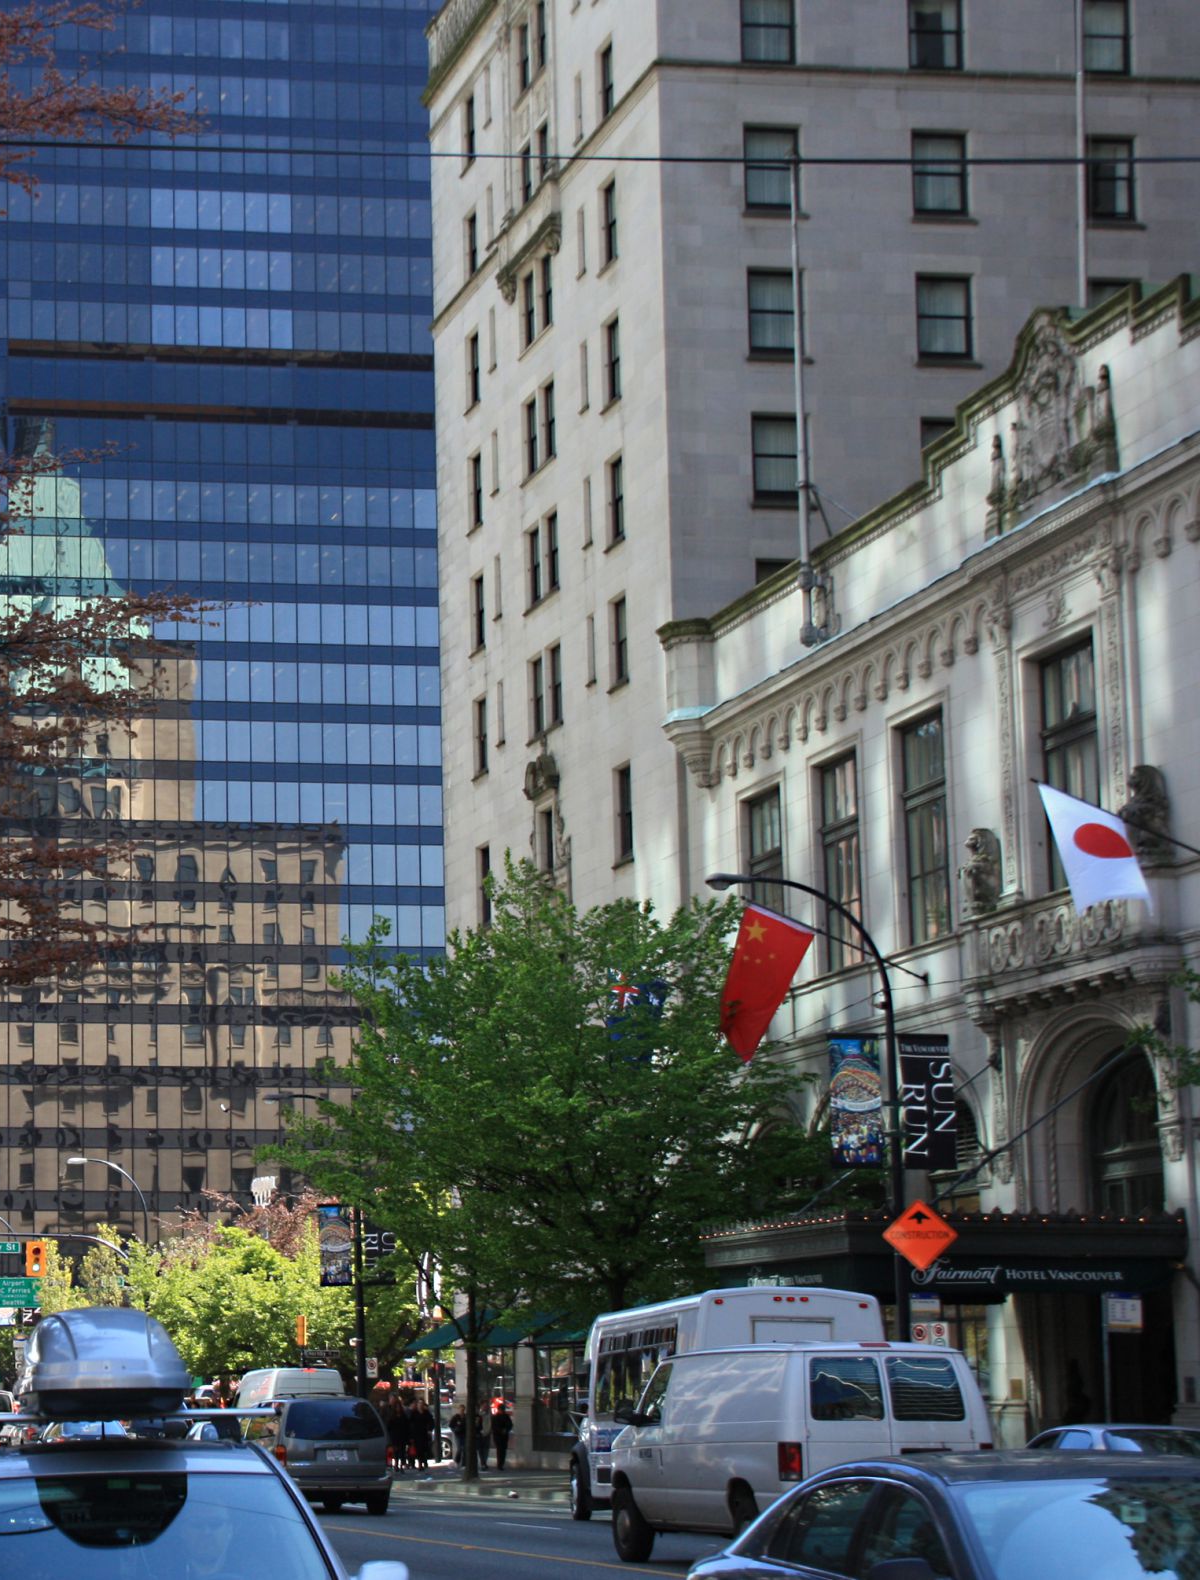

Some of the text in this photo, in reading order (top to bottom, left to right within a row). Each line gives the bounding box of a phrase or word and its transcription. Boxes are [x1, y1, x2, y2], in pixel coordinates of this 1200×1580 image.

[929, 1061, 957, 1132] SUN
[902, 1083, 928, 1156] RUN
[6, 1242, 16, 1251] St
[890, 1230, 950, 1240] CONSTRUCTION
[911, 1257, 1124, 1285] Fairmont HOTEL VANCOUVER
